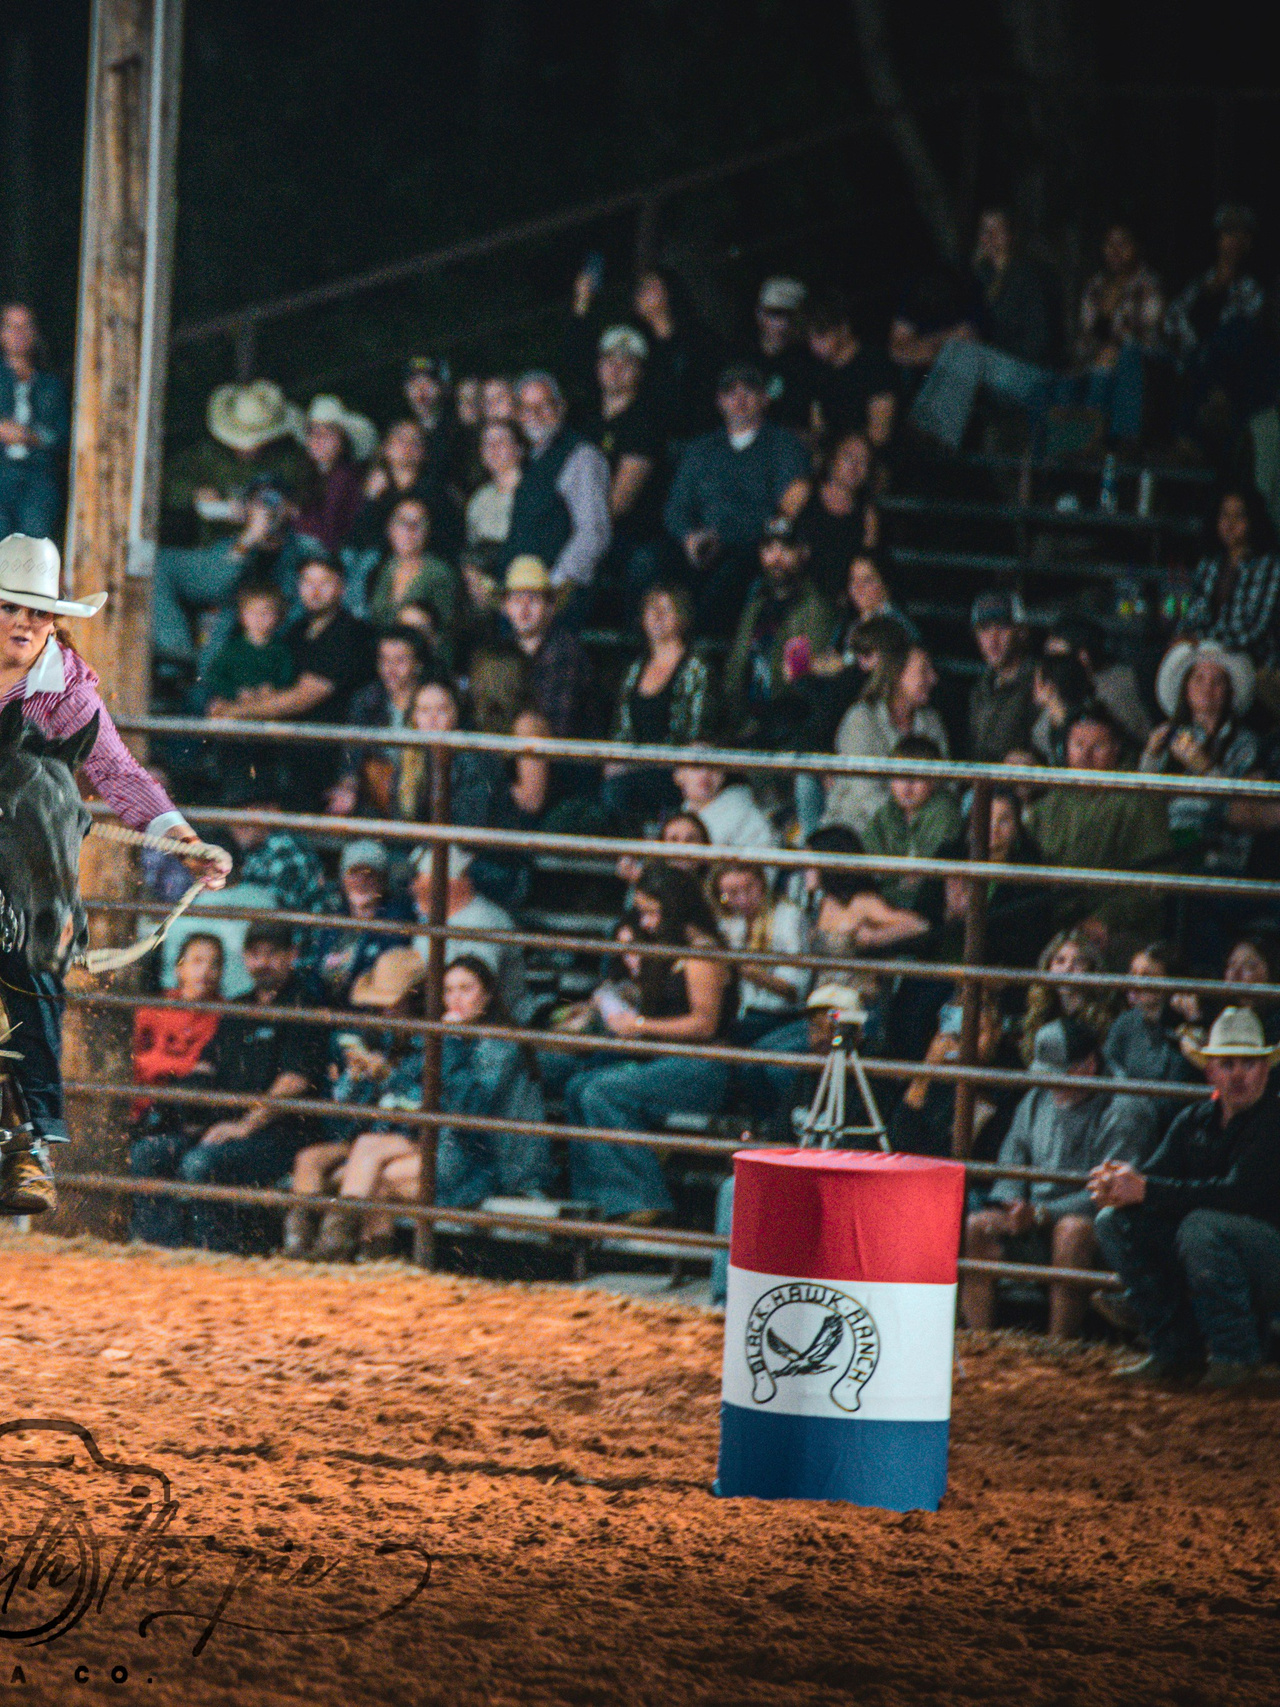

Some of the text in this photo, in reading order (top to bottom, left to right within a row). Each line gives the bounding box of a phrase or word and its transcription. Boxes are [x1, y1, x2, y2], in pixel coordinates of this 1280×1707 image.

[747, 1285, 876, 1384] BLACK HAWK RANCH
